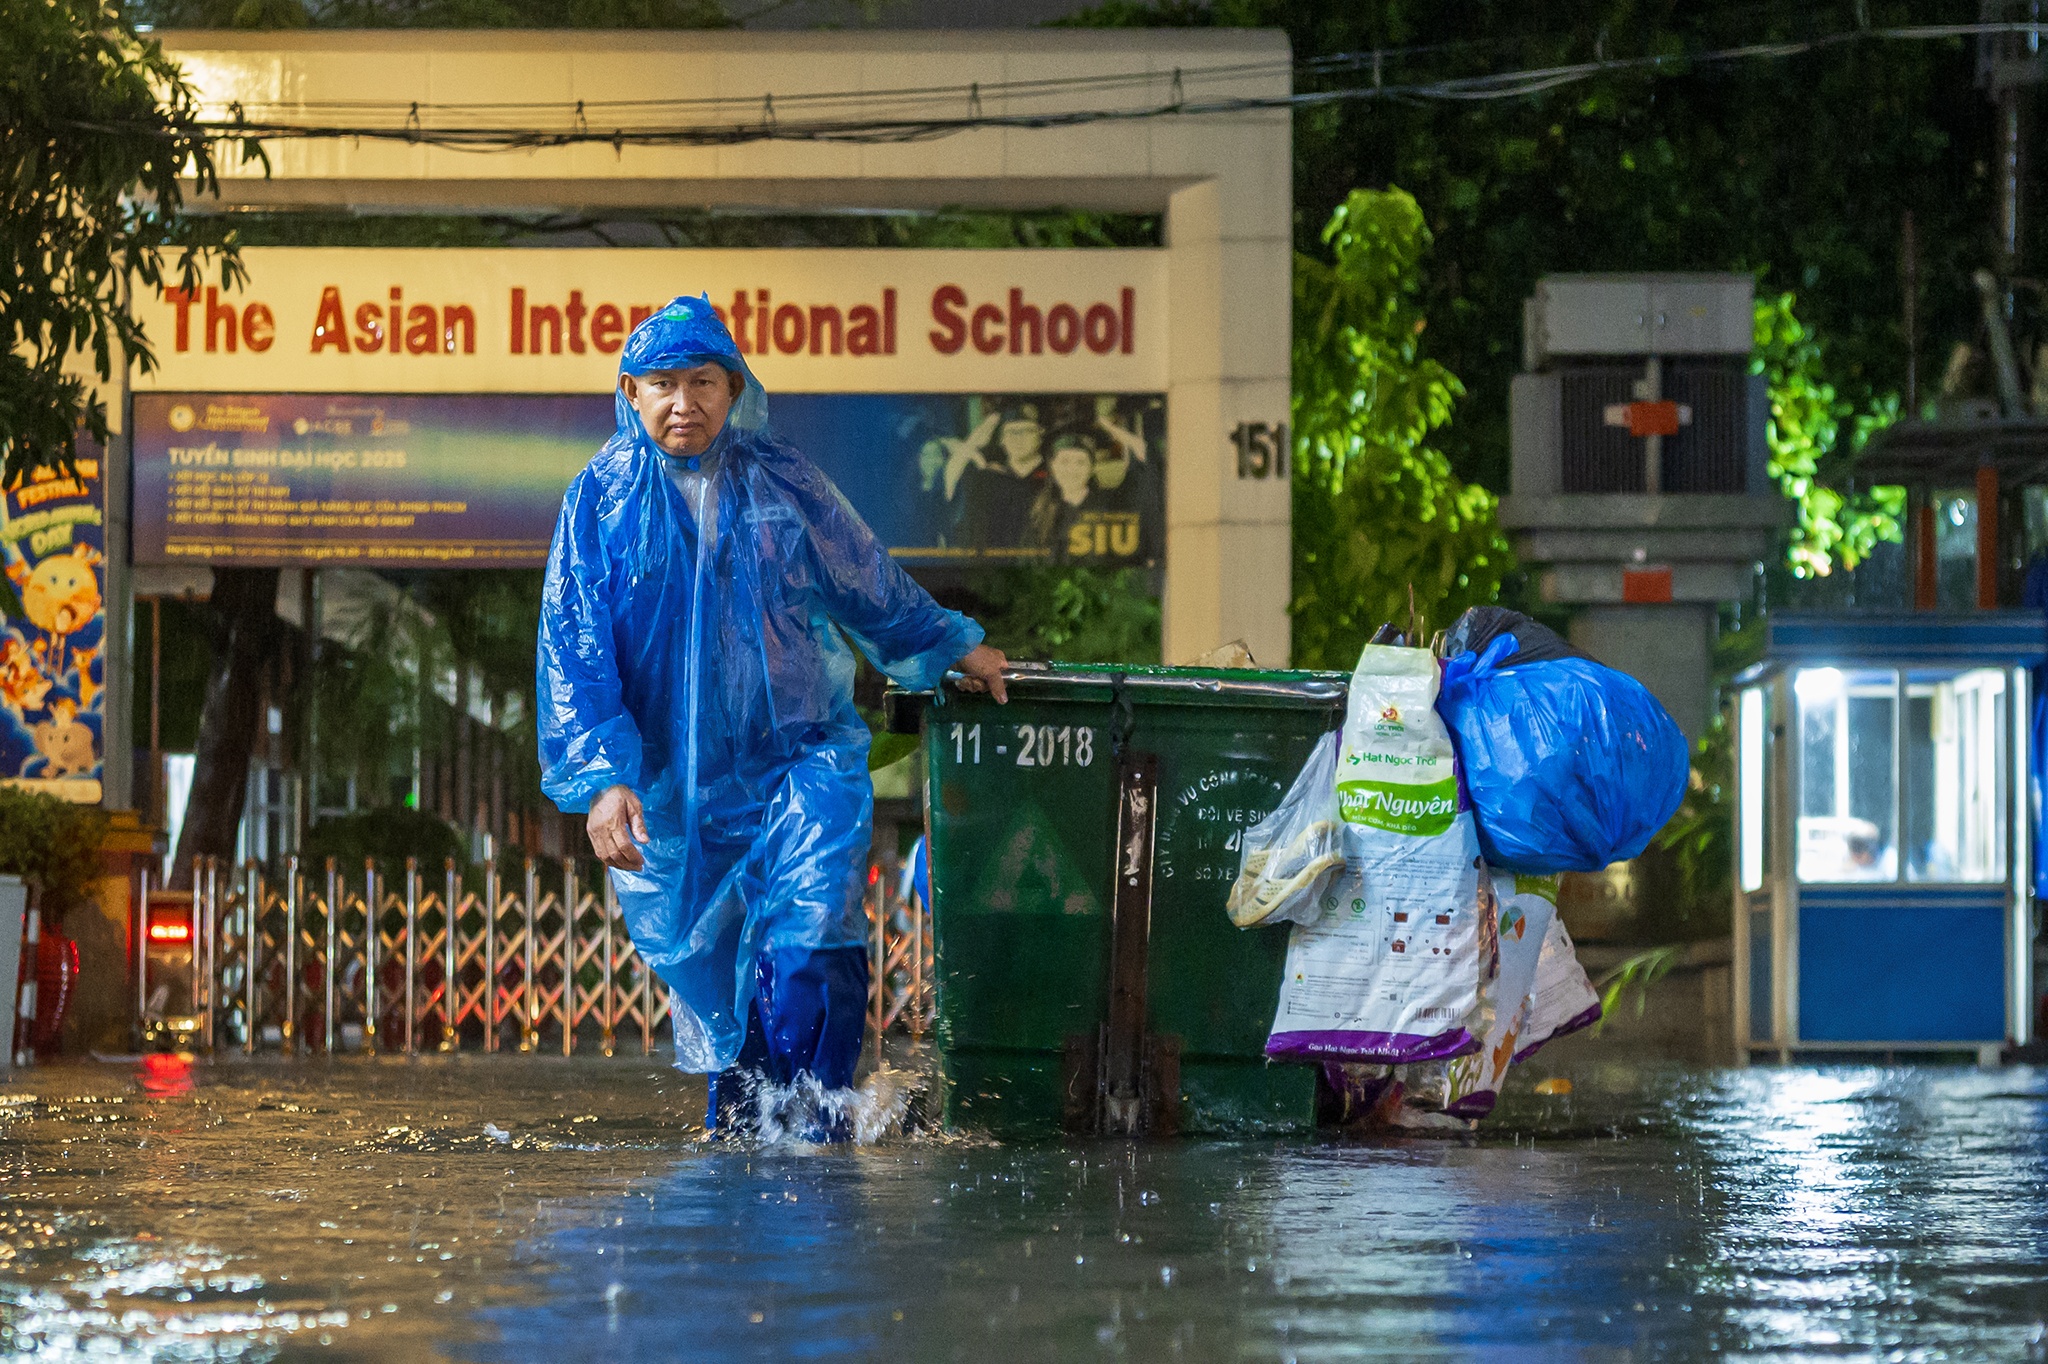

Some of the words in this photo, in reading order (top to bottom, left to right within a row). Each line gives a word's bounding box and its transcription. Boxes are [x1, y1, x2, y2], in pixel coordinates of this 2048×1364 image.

[164, 286, 275, 354] The
[310, 285, 475, 354] Asian
[511, 287, 897, 356] Intertional
[928, 284, 1135, 356] School
[1229, 422, 1288, 480] 151
[1068, 523, 1140, 557] SIU
[950, 722, 981, 764] 11
[1016, 724, 1094, 767] 2018
[1374, 790, 1454, 819] Nguyên
